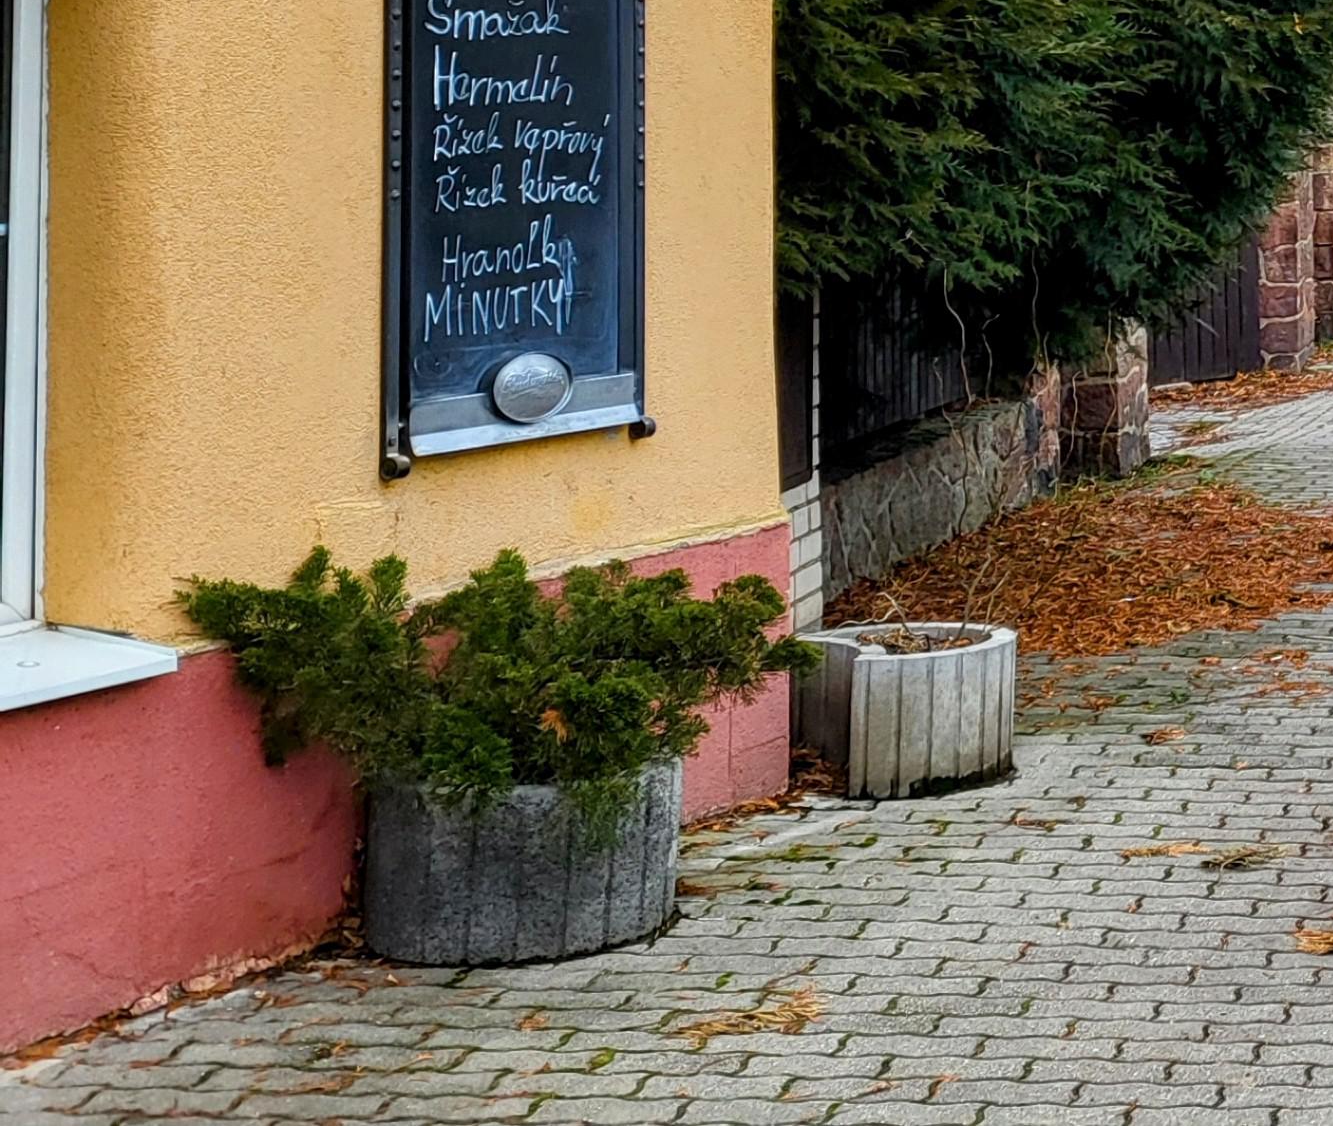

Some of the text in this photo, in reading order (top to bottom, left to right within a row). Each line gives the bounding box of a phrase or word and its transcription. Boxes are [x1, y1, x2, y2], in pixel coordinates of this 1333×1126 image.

[434, 44, 574, 111] Hermelín
[433, 111, 504, 162] Řízek
[435, 163, 507, 213] Řízek
